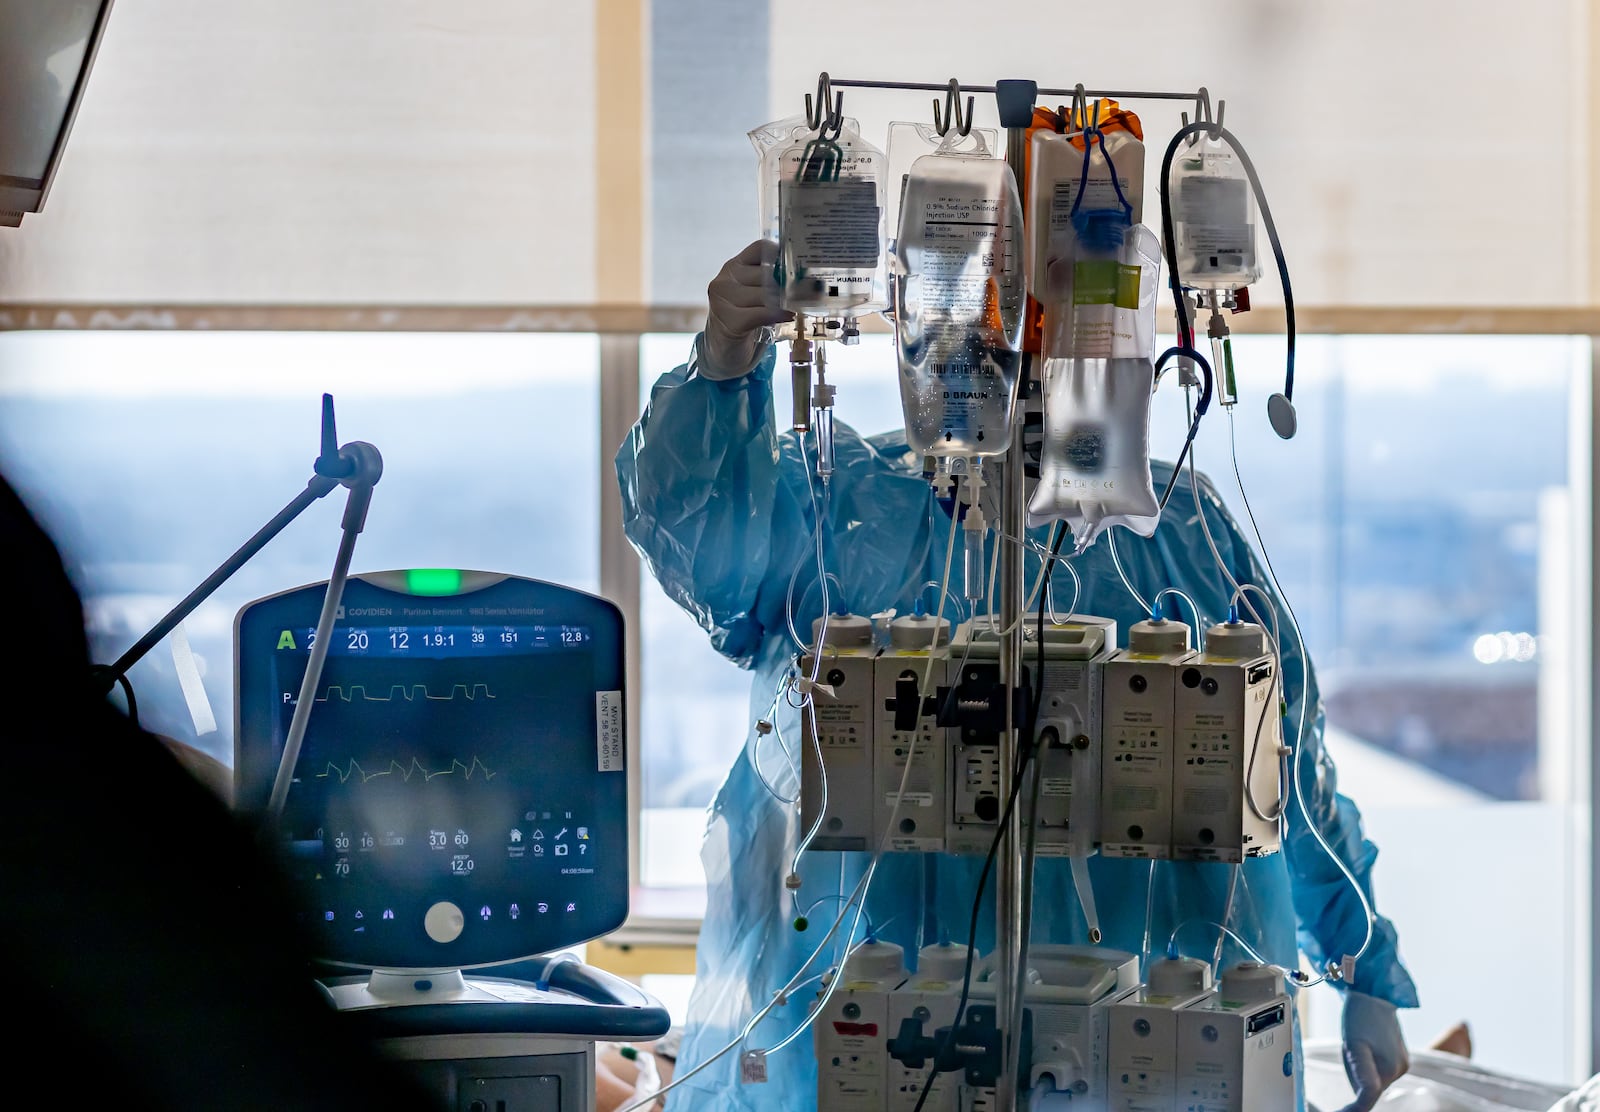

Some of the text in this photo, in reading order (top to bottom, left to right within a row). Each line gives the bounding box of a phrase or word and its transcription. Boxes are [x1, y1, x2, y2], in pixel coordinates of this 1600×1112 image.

[946, 203, 970, 211] Sodium
[971, 204, 998, 212] Chloride
[926, 212, 955, 220] Injection
[953, 391, 988, 399] BRAUN
[349, 607, 392, 616] COVIDIEN
[403, 607, 431, 617] Puritan
[277, 630, 296, 650] A
[347, 633, 369, 649] 20
[389, 632, 409, 649] 12
[422, 633, 455, 647] 1.9:1
[471, 633, 485, 643] 39
[499, 632, 518, 643] 151
[560, 632, 582, 642] 12.8
[601, 693, 609, 717] VENT
[610, 705, 619, 757] MVH STAND
[335, 837, 349, 848] 30
[360, 836, 374, 847] 16
[429, 835, 447, 846] 3.0
[454, 834, 469, 845] 60
[335, 863, 349, 875] 70
[450, 859, 474, 871] 12.0
